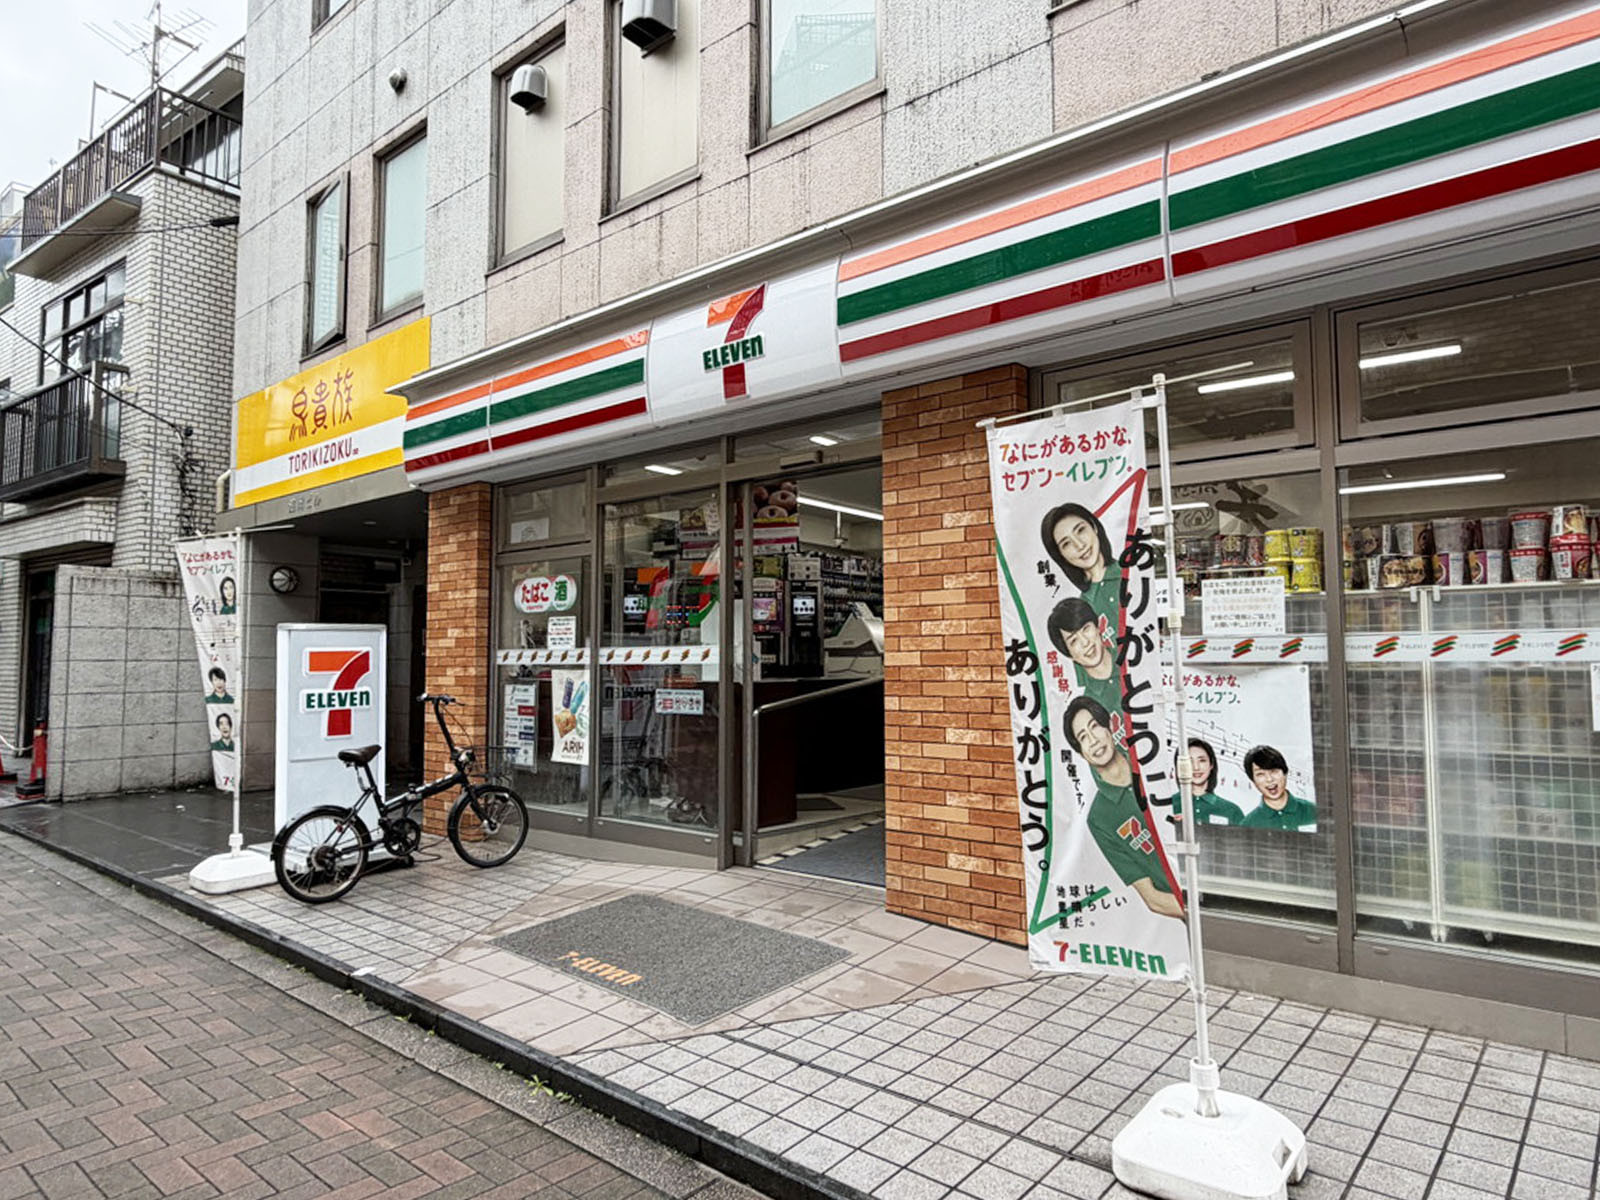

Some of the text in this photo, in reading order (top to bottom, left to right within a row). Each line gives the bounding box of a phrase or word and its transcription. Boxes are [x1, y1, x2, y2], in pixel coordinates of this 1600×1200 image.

[288, 436, 353, 474] TORIKIZOKU
[521, 580, 568, 604] たばこ 酒
[1005, 638, 1052, 872] ありがとう。
